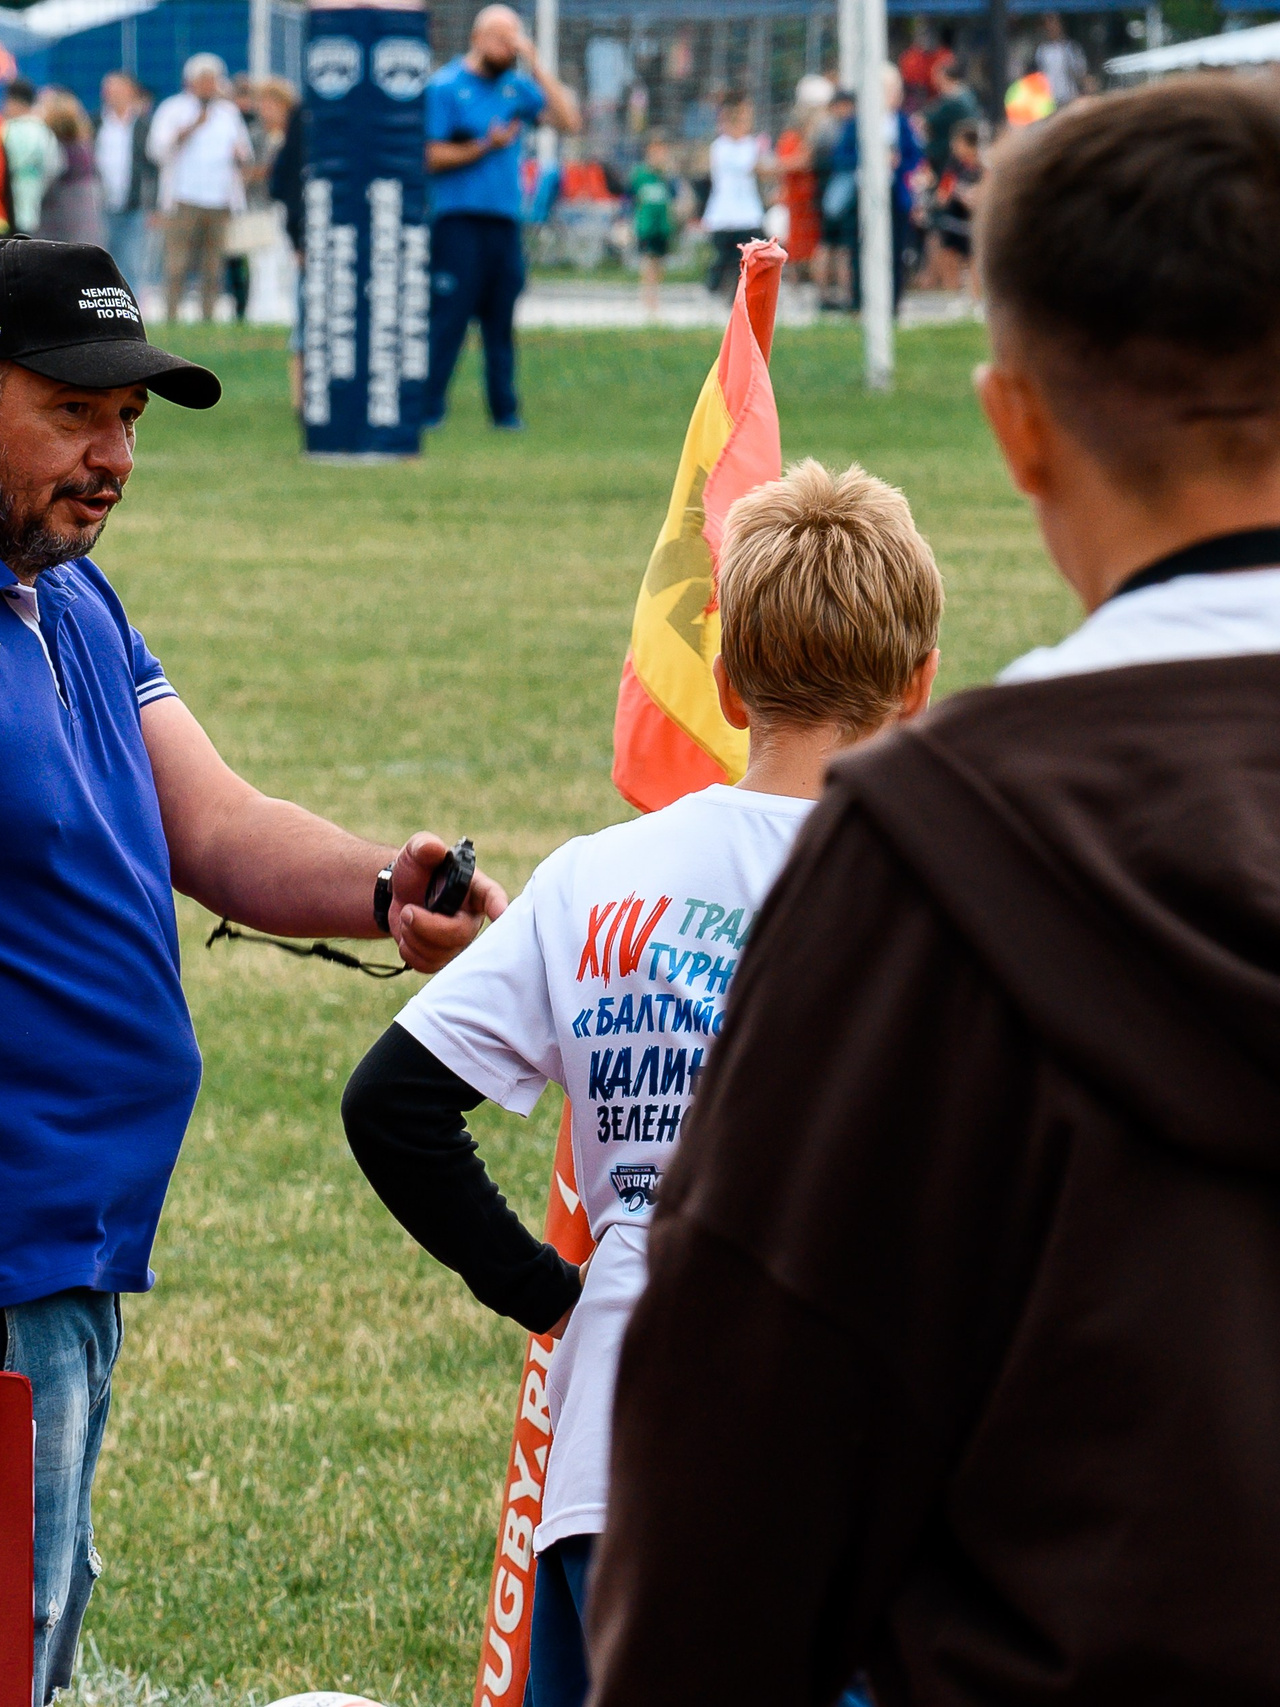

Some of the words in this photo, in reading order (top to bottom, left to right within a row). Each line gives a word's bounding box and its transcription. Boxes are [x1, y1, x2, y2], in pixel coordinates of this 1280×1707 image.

[78, 297, 128, 309] ВЫСШЕЙ
[97, 309, 115, 319] ПО
[576, 891, 673, 989] XIV
[612, 1174, 664, 1193] ШТОРМ
